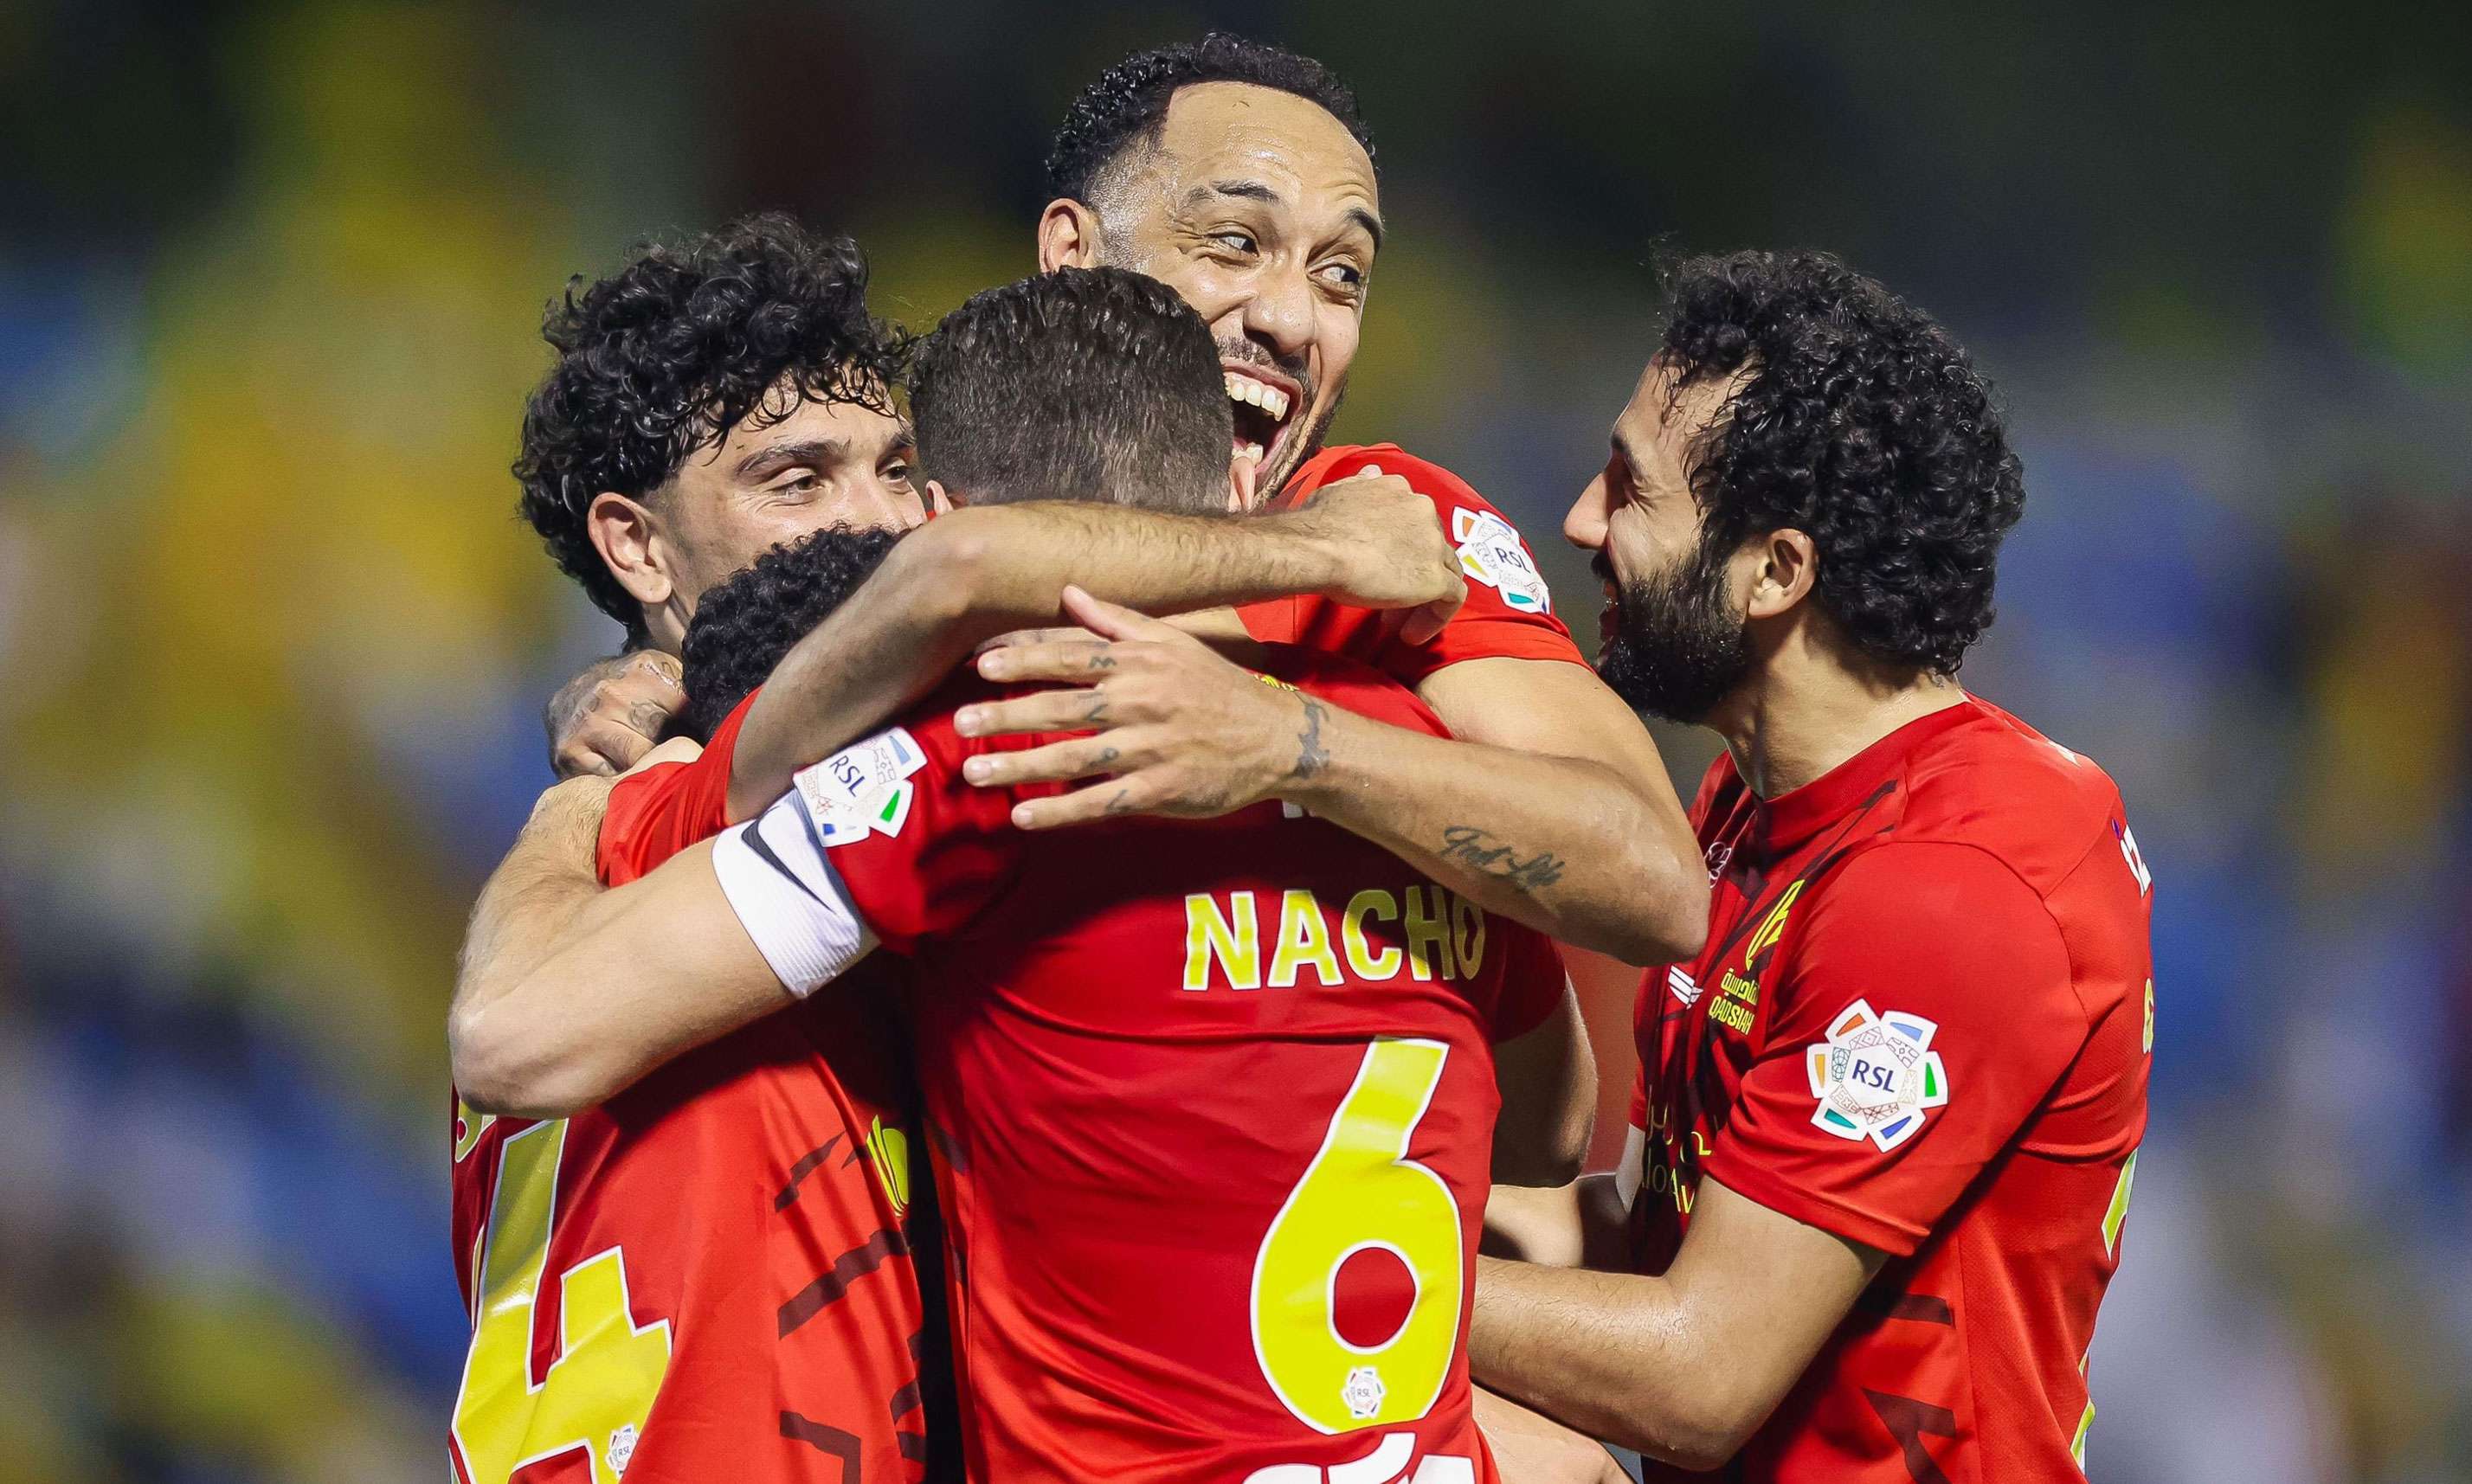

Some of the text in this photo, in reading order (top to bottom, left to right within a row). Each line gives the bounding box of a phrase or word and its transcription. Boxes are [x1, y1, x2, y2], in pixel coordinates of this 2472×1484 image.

[1495, 546, 1531, 574] RSL
[828, 755, 866, 798] RSL
[1182, 885, 1485, 992] NACHO
[1708, 995, 1755, 1036] QADSIAH
[1851, 1058, 1896, 1094] RSL
[1250, 1033, 1464, 1436] 6
[1356, 1387, 1371, 1398] RSL
[617, 1445, 631, 1457] RSL
